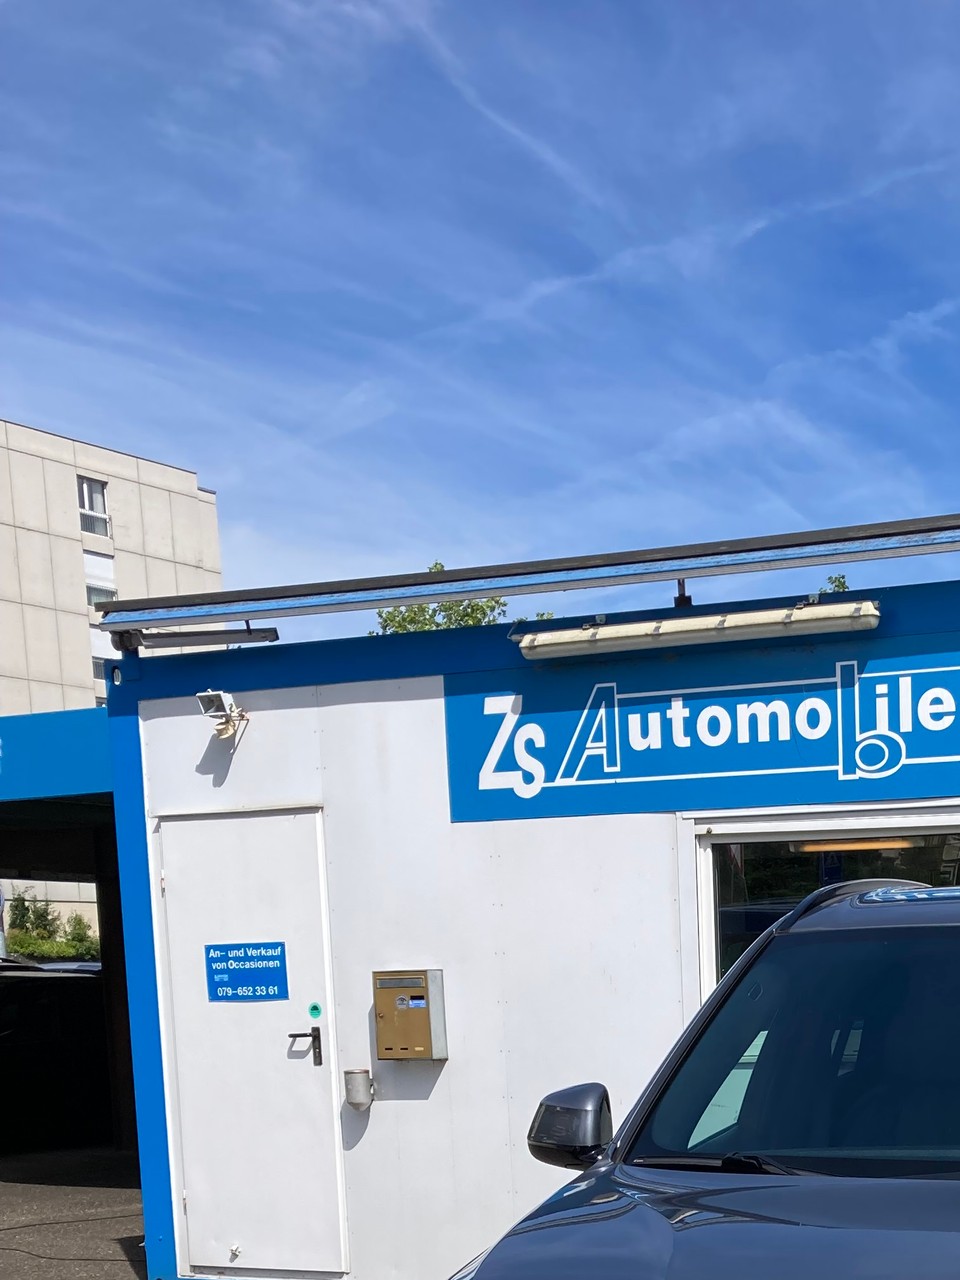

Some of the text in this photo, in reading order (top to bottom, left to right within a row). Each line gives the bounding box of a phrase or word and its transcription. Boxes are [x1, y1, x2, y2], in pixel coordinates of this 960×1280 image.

[555, 661, 958, 781] Automobile
[228, 948, 245, 957] und
[246, 946, 281, 957] Verkauf
[211, 959, 280, 970] von Occasionen
[217, 986, 278, 997] 079-652 33 61
